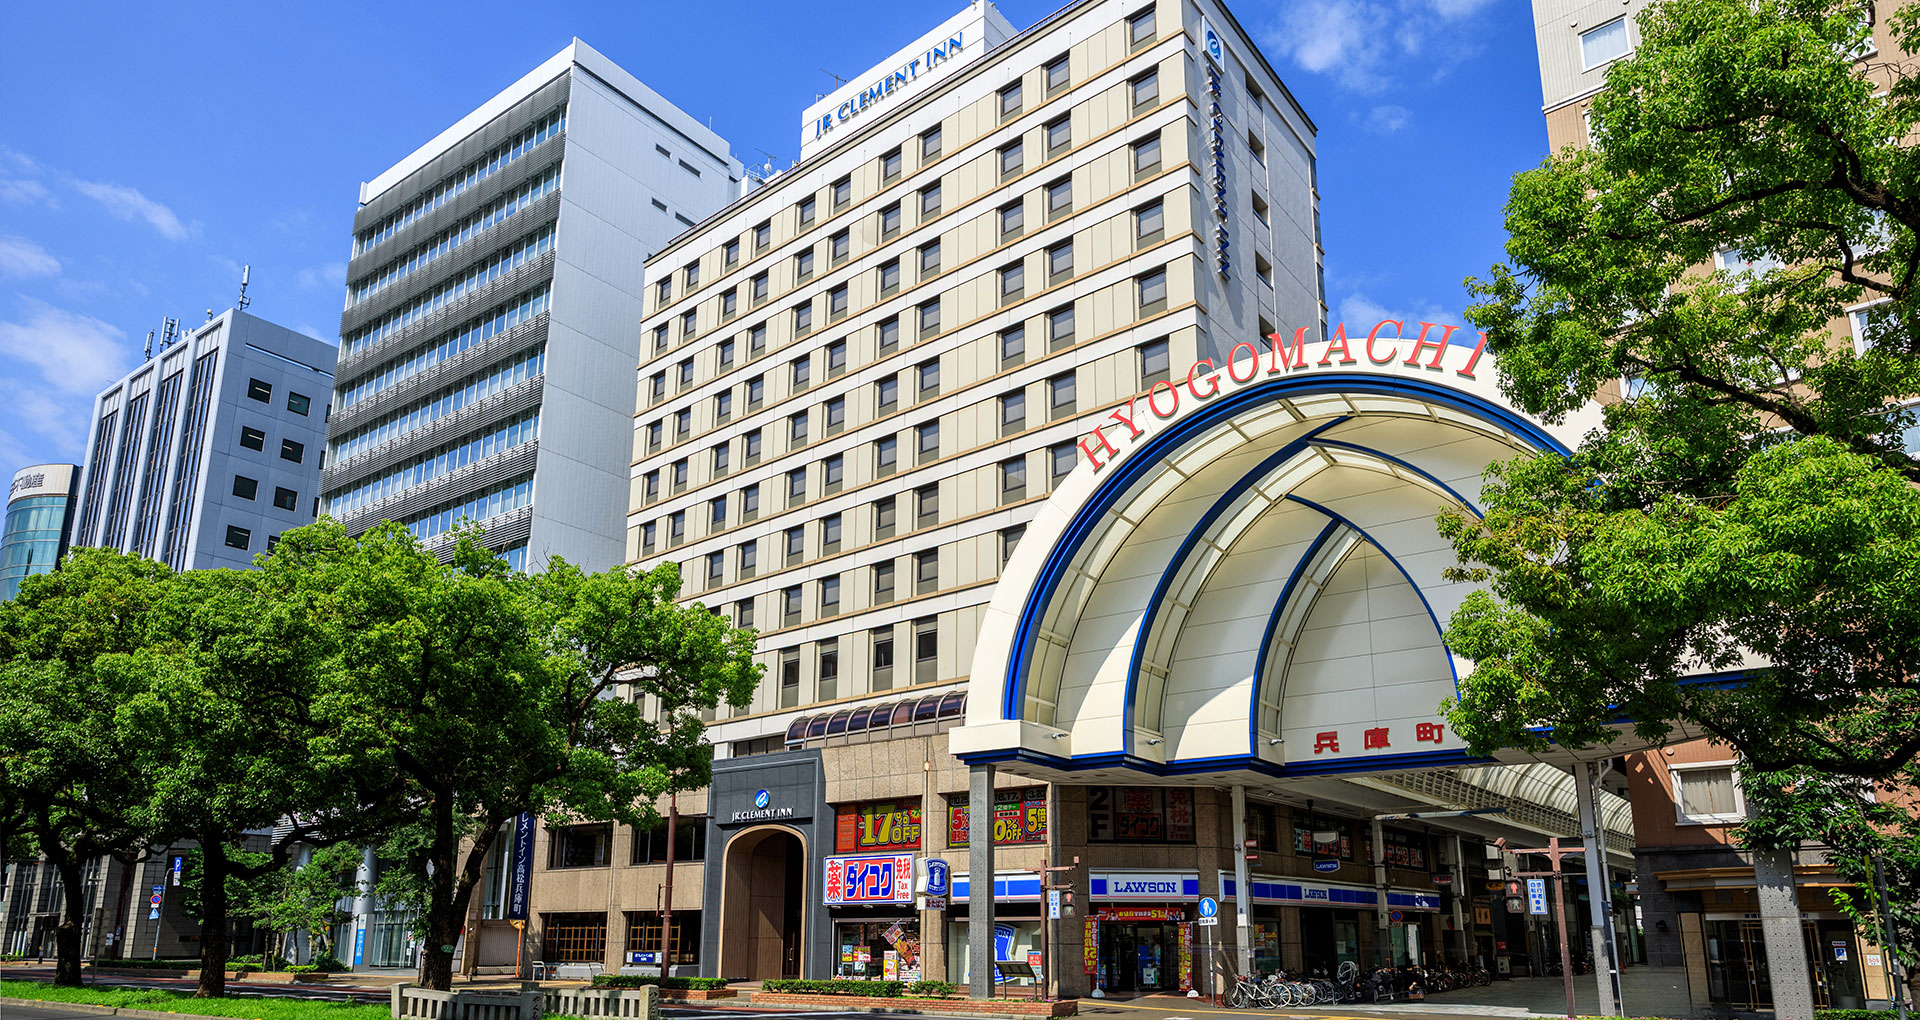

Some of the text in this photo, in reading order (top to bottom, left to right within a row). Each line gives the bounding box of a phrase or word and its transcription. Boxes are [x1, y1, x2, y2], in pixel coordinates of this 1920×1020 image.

[816, 32, 963, 138] JR CLEMENT INN
[1076, 319, 1489, 473] HYOGOMACHI
[1313, 722, 1445, 755] 兵庫町
[731, 807, 794, 822] JR CLEMENT INN
[1170, 789, 1188, 823] 免税
[892, 825, 919, 842] OFF
[1120, 815, 1159, 836] ダイコク
[1173, 824, 1187, 832] Tax
[1006, 828, 1022, 841] OFF
[895, 857, 911, 880] 免税
[845, 861, 893, 898] ダイコク
[897, 880, 908, 890] Tax
[1113, 881, 1177, 893] LAWSON
[896, 890, 909, 900] Free
[1304, 888, 1327, 899] LAWSON
